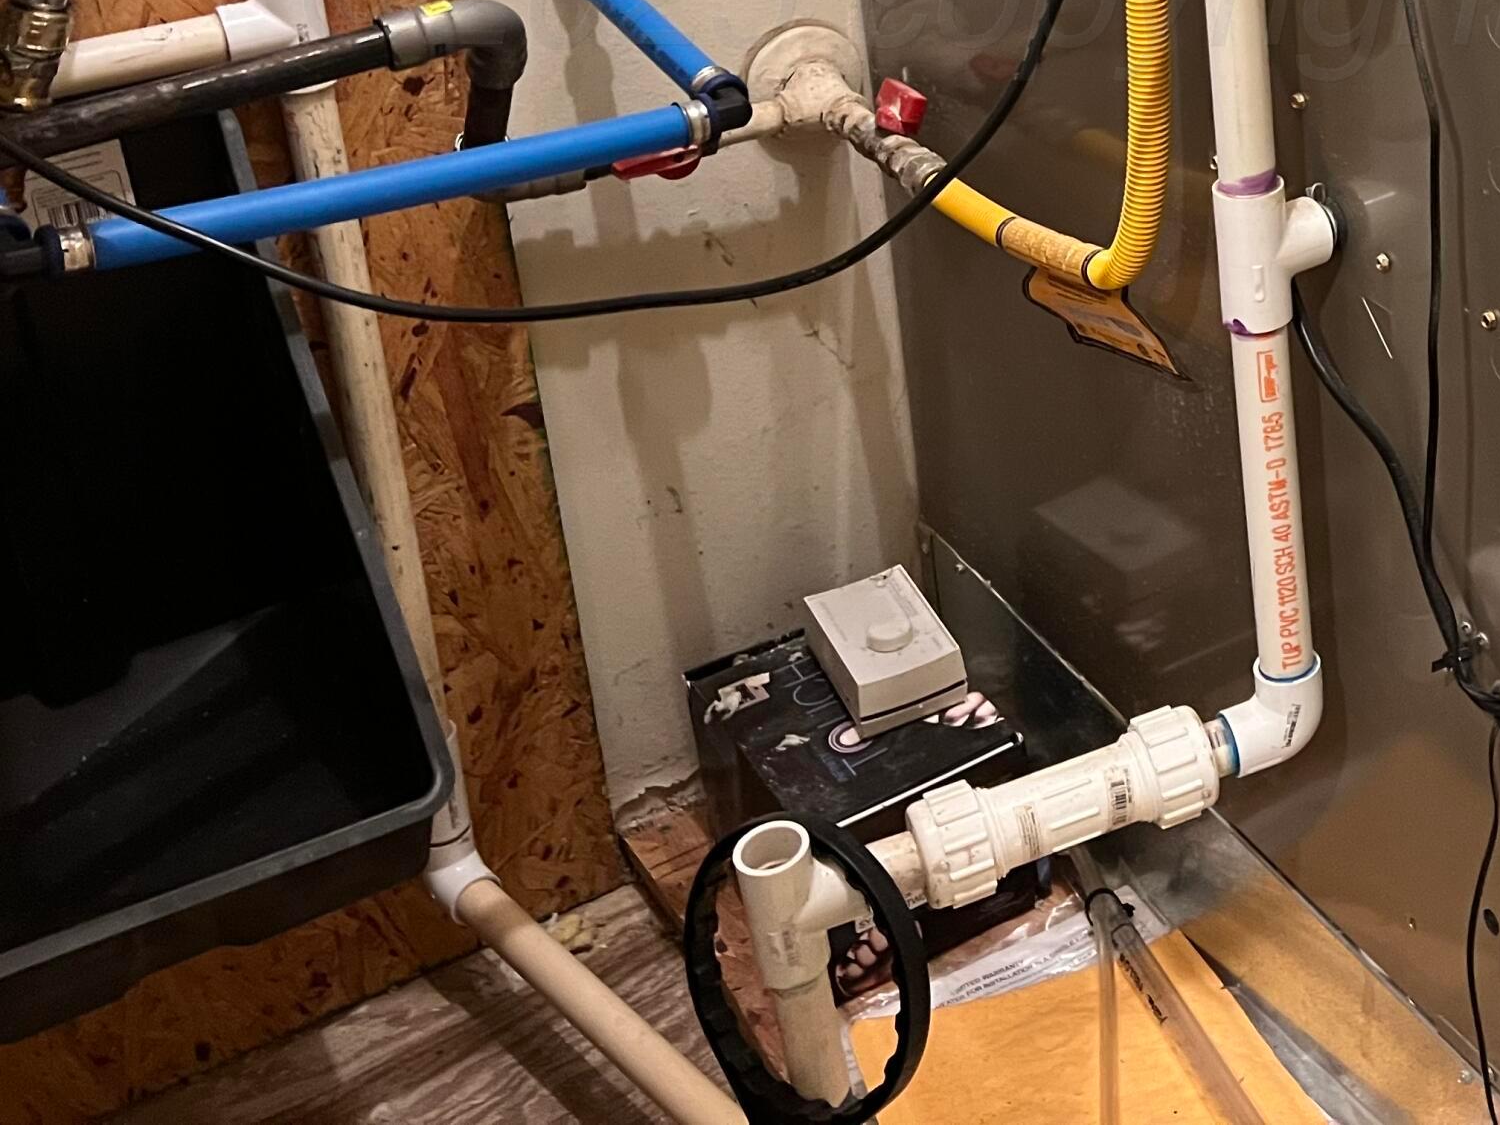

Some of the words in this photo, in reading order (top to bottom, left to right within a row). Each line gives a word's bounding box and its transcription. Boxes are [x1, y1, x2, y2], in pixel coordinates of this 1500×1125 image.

[1273, 524, 1292, 544] 40
[1274, 546, 1296, 576] SCH
[1278, 575, 1298, 609] 1120
[1279, 606, 1300, 640] PVC
[1281, 638, 1303, 671] TUP
